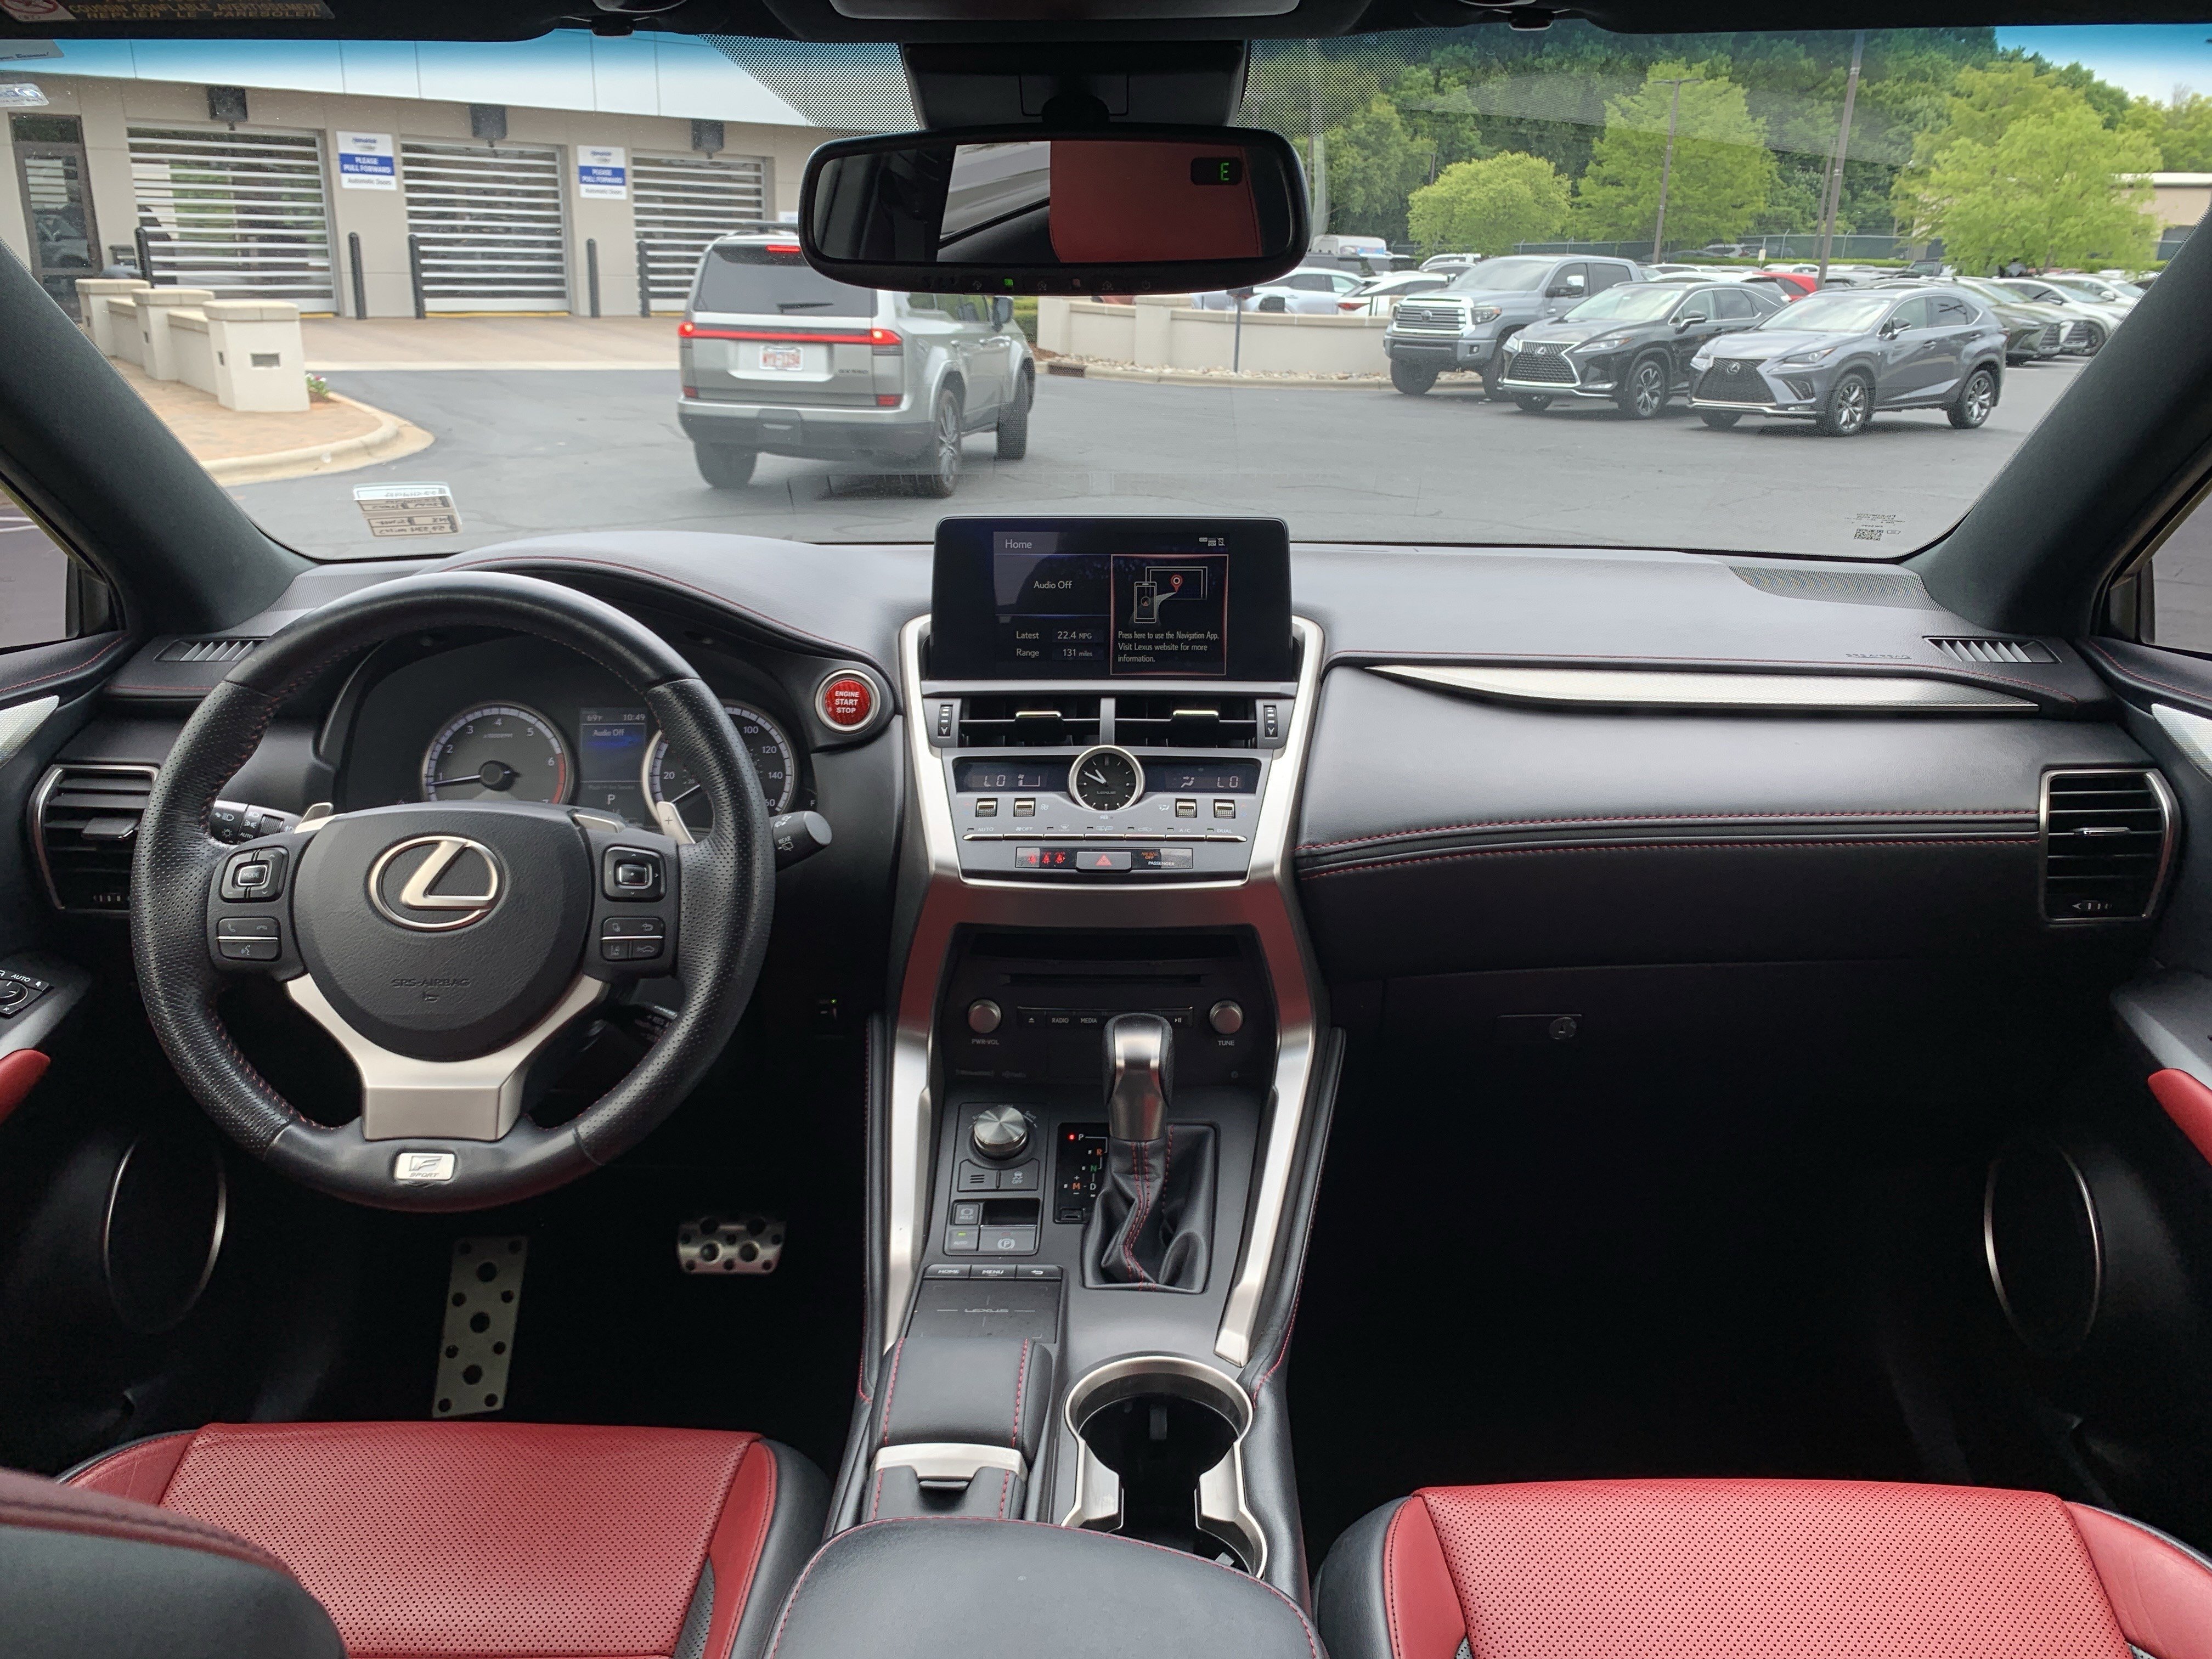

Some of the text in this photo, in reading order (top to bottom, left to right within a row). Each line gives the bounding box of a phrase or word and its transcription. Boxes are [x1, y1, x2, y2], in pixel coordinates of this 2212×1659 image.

[1221, 162, 1229, 181] E
[1005, 539, 1032, 549] Home
[1033, 580, 1073, 589] Audio Off
[1016, 631, 1039, 639] Latest
[1057, 631, 1077, 639] 22.4
[1176, 631, 1205, 641] Navigation
[1206, 631, 1220, 640] App.
[1118, 642, 1132, 651] Visit
[1134, 642, 1153, 651] Lexus
[1154, 642, 1179, 651] website
[1180, 642, 1189, 651] for
[1016, 648, 1040, 658] Range
[1063, 648, 1076, 657] 131
[1118, 654, 1155, 663] information.
[494, 718, 502, 726] 4
[466, 725, 473, 734] 3
[526, 727, 534, 736] 5
[743, 726, 759, 734] 100
[446, 744, 453, 754] 2
[761, 746, 777, 754] 120
[548, 757, 555, 766] 6
[663, 771, 675, 780] 20
[768, 771, 783, 780] 140
[607, 794, 615, 805] P
[765, 798, 775, 806] 60
[778, 836, 792, 844] REAR
[11, 974, 31, 983] AUTO
[1096, 1148, 1103, 1156] R
